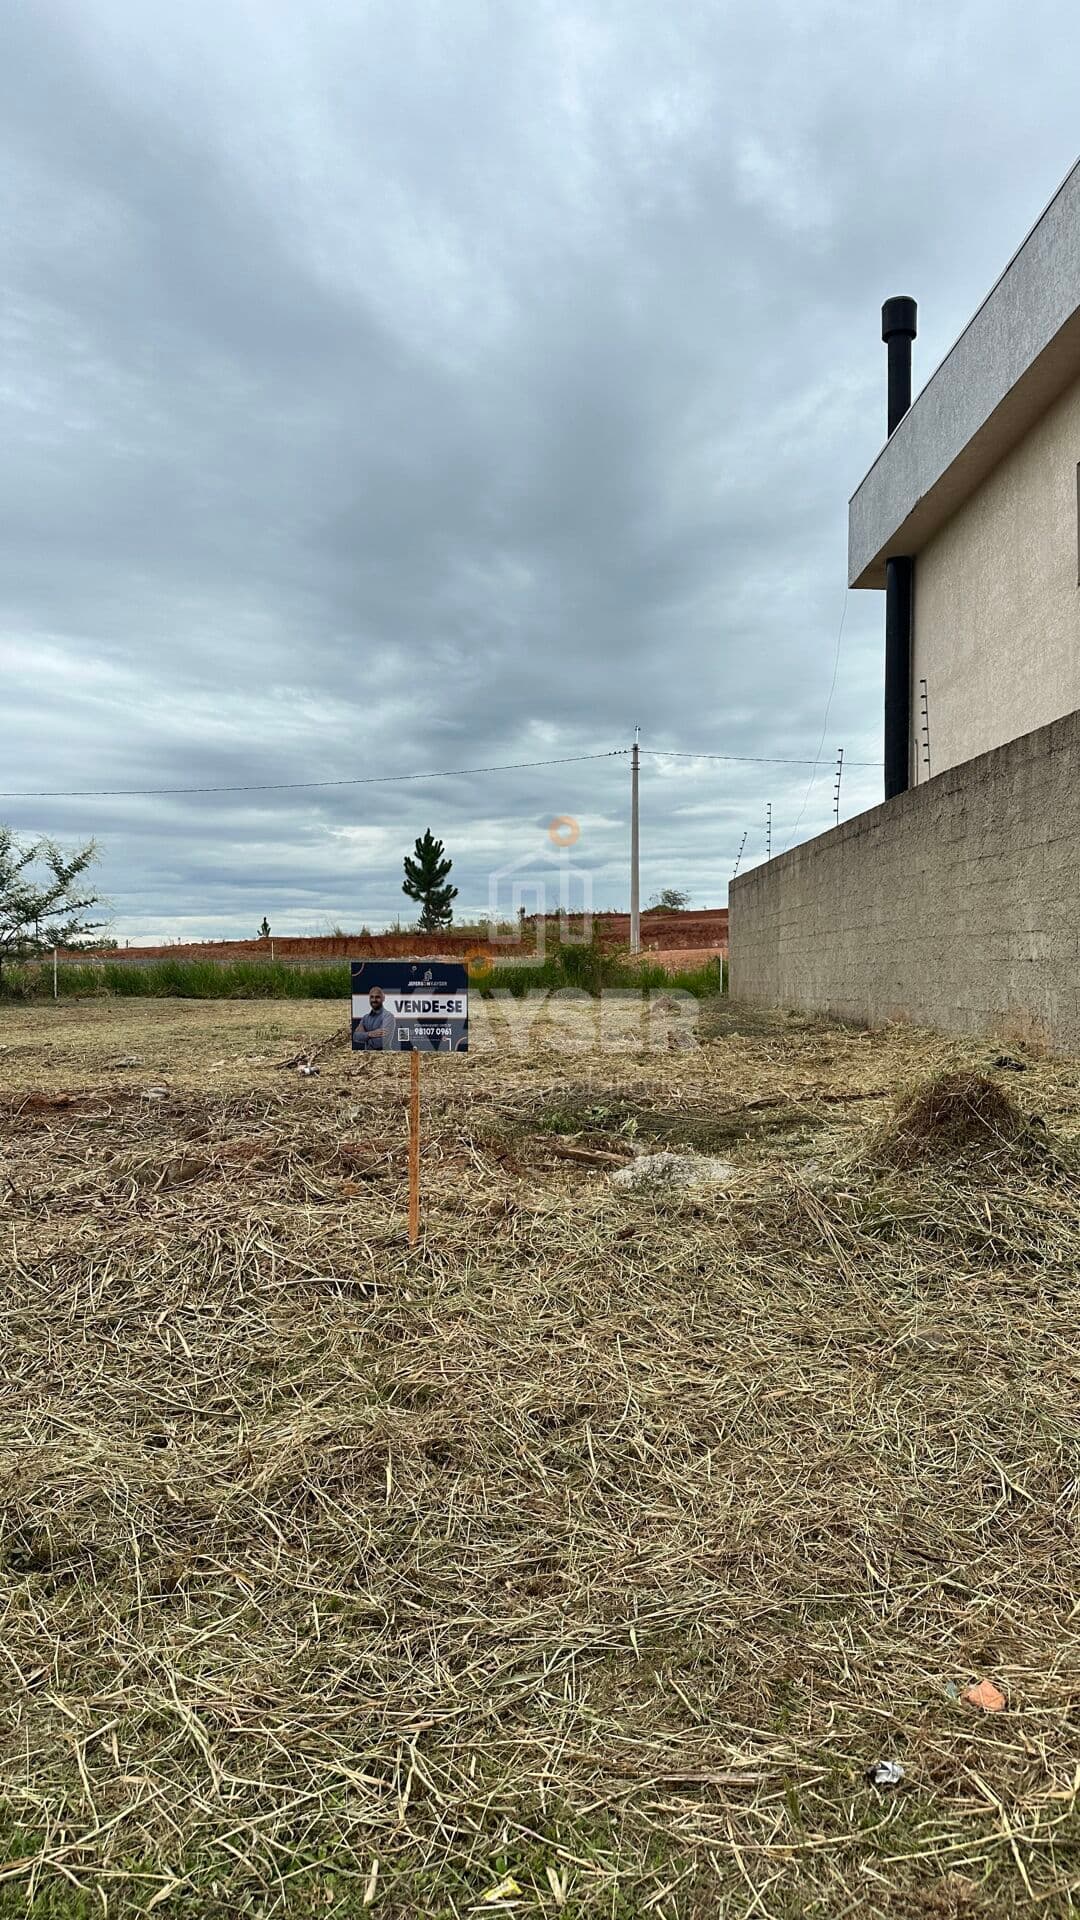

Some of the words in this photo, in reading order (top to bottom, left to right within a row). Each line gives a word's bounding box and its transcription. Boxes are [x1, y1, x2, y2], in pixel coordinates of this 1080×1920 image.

[394, 1000, 462, 1013] VENDE-SE
[414, 1027, 435, 1036] 98107
[435, 1027, 452, 1036] 0961
